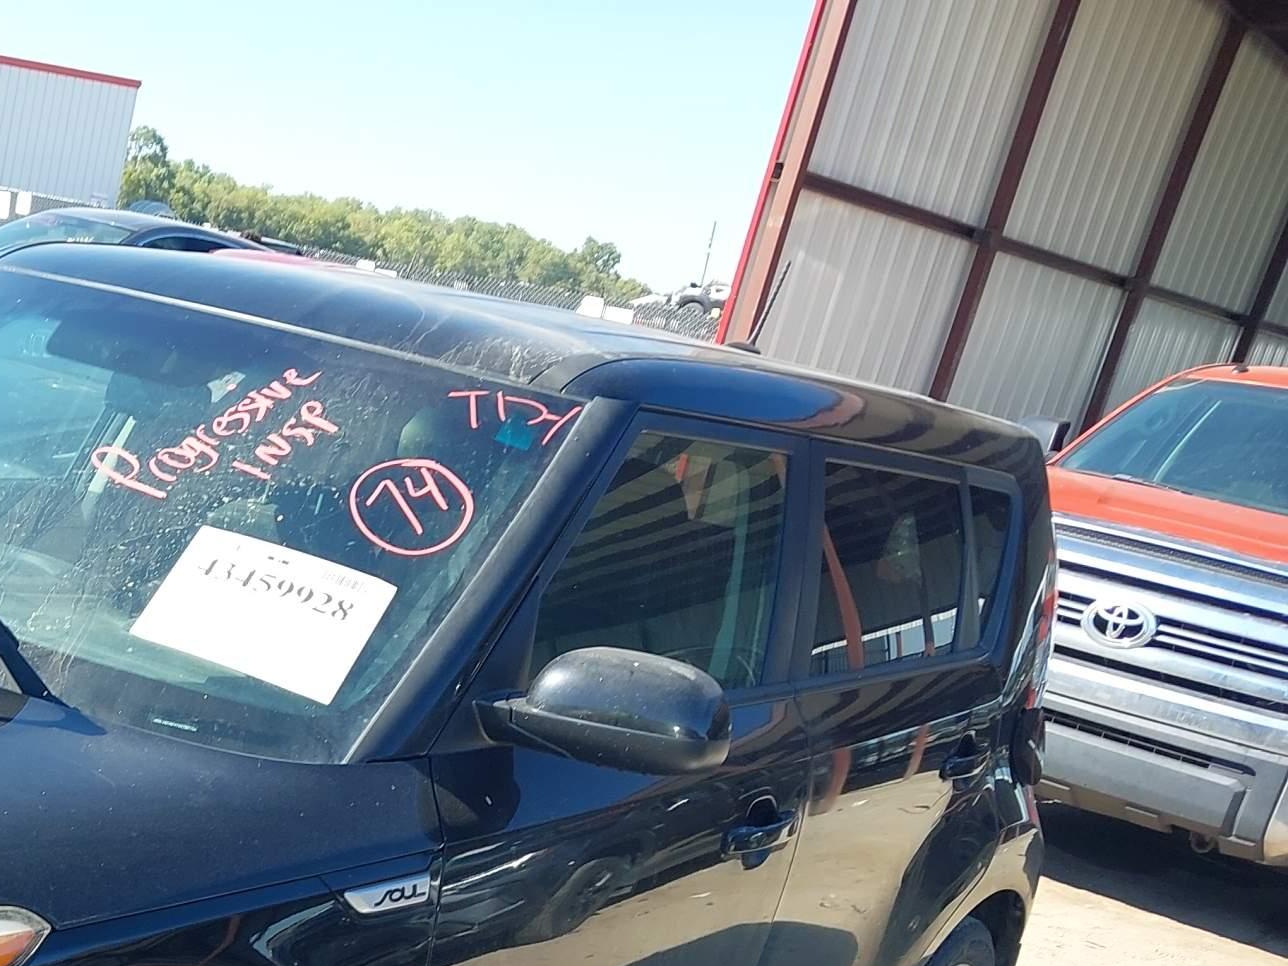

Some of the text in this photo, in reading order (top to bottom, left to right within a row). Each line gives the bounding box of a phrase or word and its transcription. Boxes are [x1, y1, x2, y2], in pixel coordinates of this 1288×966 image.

[231, 400, 340, 480] INSP
[365, 466, 449, 535] 74
[198, 558, 355, 621] 43459928
